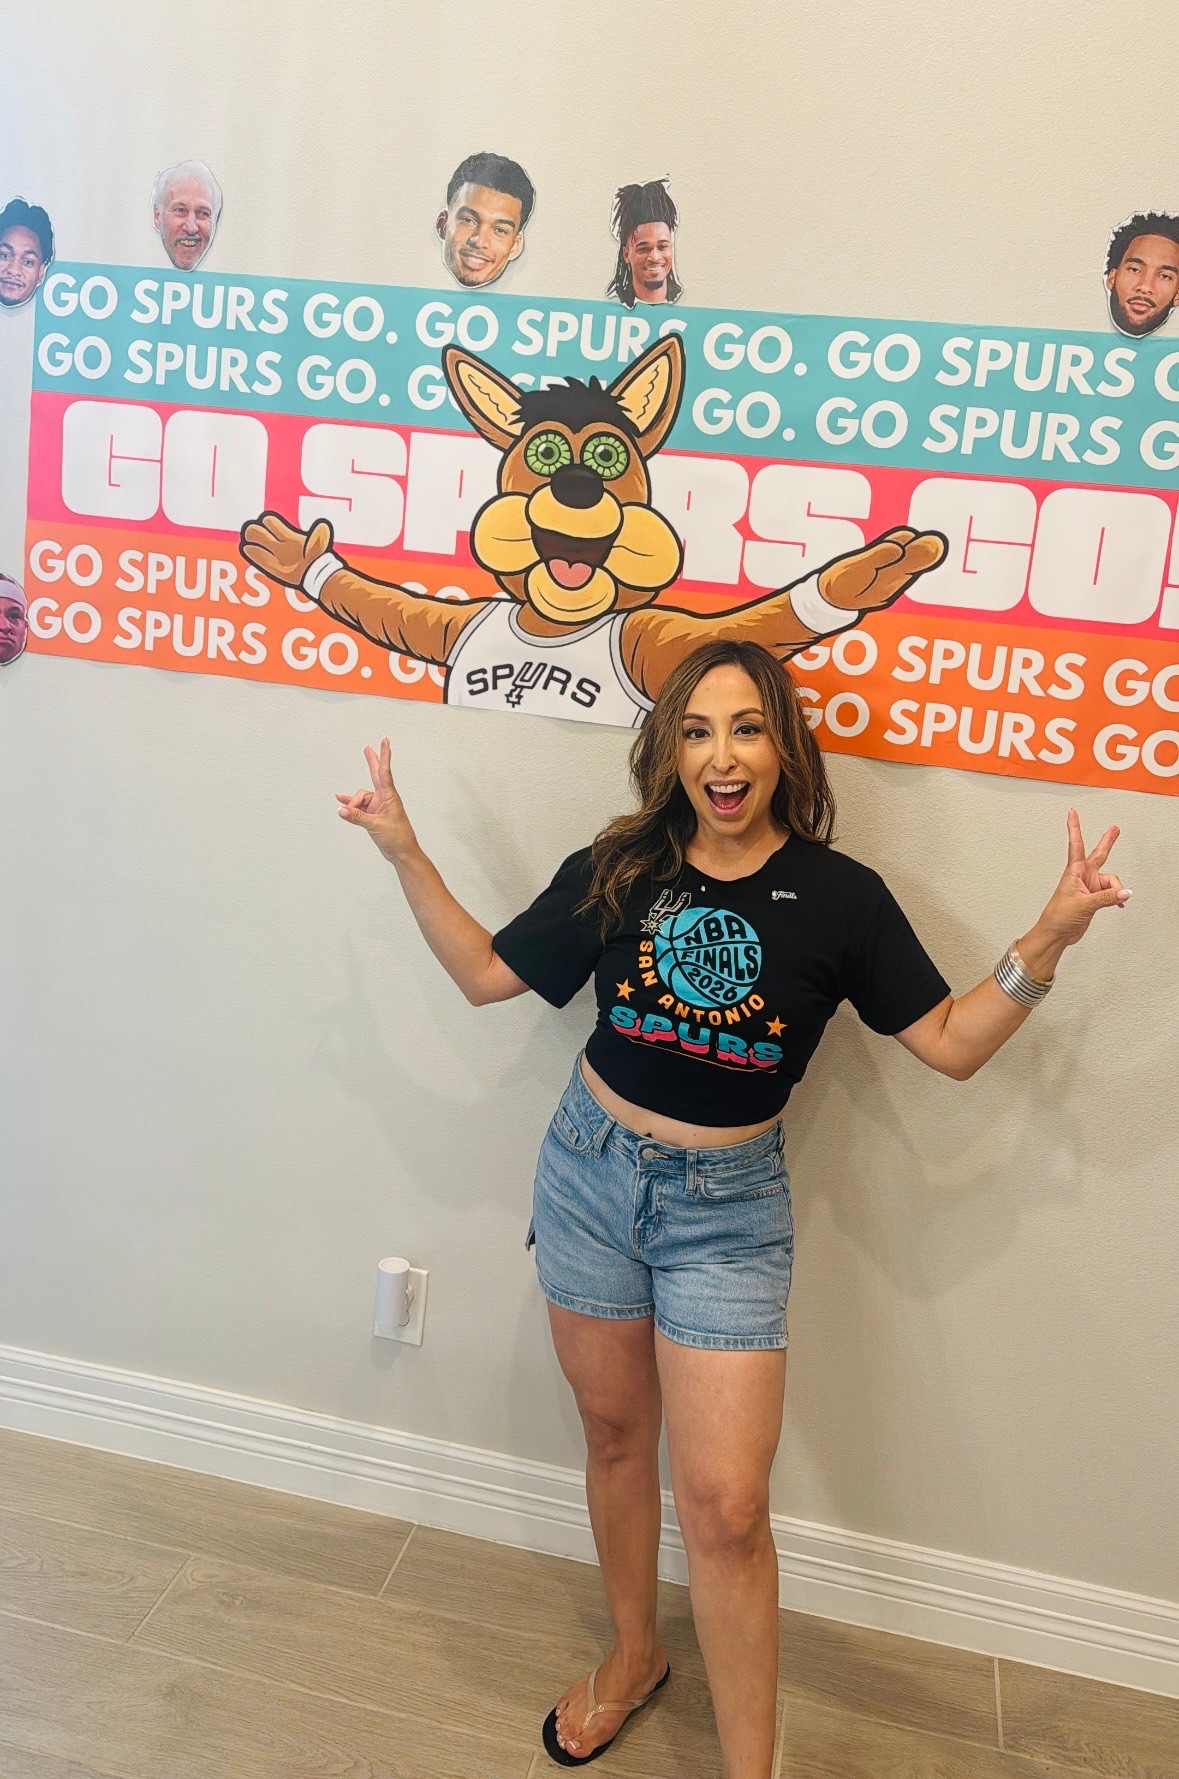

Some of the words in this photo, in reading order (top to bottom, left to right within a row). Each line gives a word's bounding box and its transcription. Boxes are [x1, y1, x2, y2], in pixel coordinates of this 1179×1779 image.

[43, 273, 118, 320] GO
[130, 279, 289, 334] SPURS
[303, 293, 398, 344] GO.
[415, 301, 499, 351] GO
[703, 322, 808, 376] GO.
[827, 330, 921, 382] GO
[935, 338, 1137, 397] SPURS
[37, 333, 112, 380] GO
[124, 339, 282, 396] SPURS
[297, 355, 391, 407] GO.
[407, 364, 463, 413] G
[692, 388, 796, 441] GO.
[815, 396, 909, 449] GO
[921, 404, 1124, 466] SPURS
[61, 400, 269, 532] GO
[298, 423, 872, 590] SPRS
[29, 540, 102, 586] GO
[115, 549, 271, 607] SPURS
[891, 635, 1088, 700] SPURS
[1103, 658, 1179, 713] GO
[27, 597, 102, 643] GO
[113, 607, 268, 665] SPURS
[281, 628, 372, 678] GO.
[883, 699, 1076, 765] SPURS
[1093, 724, 1179, 778] GO
[466, 661, 601, 708] SPURS
[681, 945, 758, 981] FINALS
[684, 915, 747, 946] NBA
[638, 940, 658, 987] SAN
[658, 994, 765, 1026] ANTONIO
[688, 968, 738, 1000] 2026
[609, 1006, 784, 1067] SPURS
